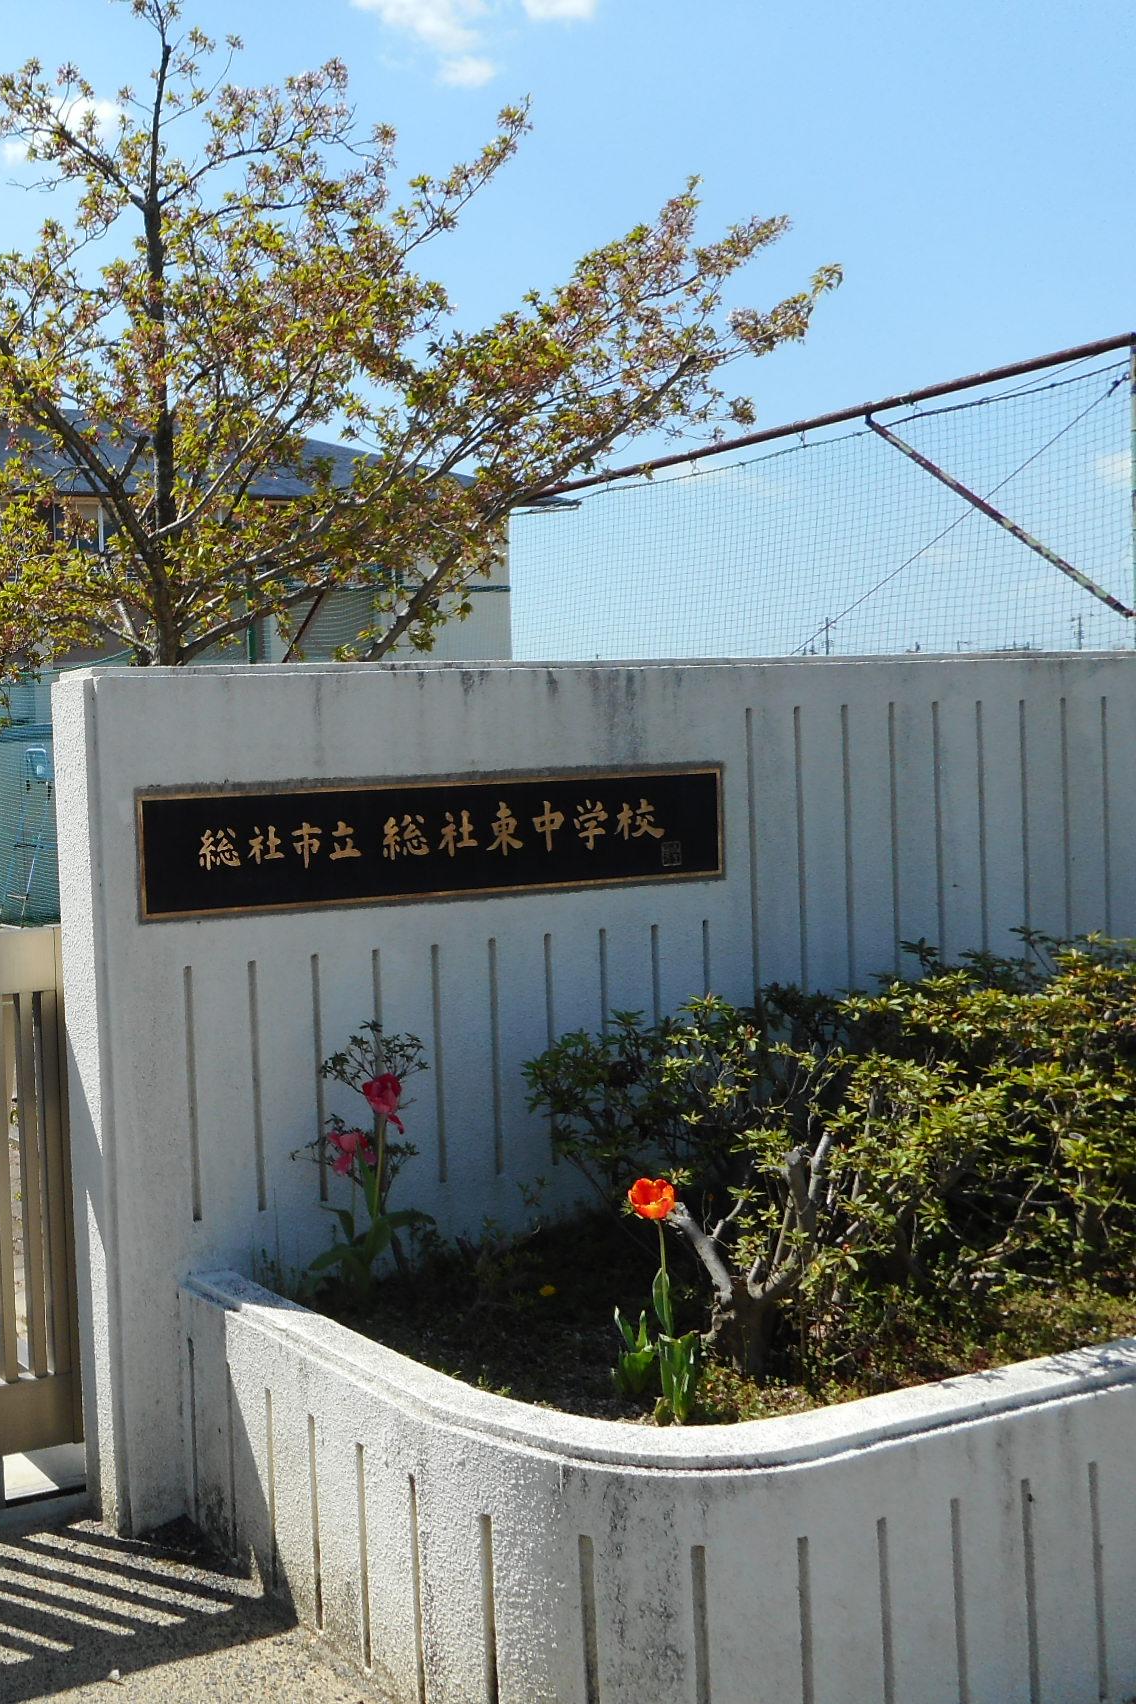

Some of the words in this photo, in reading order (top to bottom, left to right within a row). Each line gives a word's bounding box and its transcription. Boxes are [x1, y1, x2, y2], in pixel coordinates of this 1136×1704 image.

[198, 820, 362, 871] 総社市立
[382, 798, 665, 861] 総社東中学校
